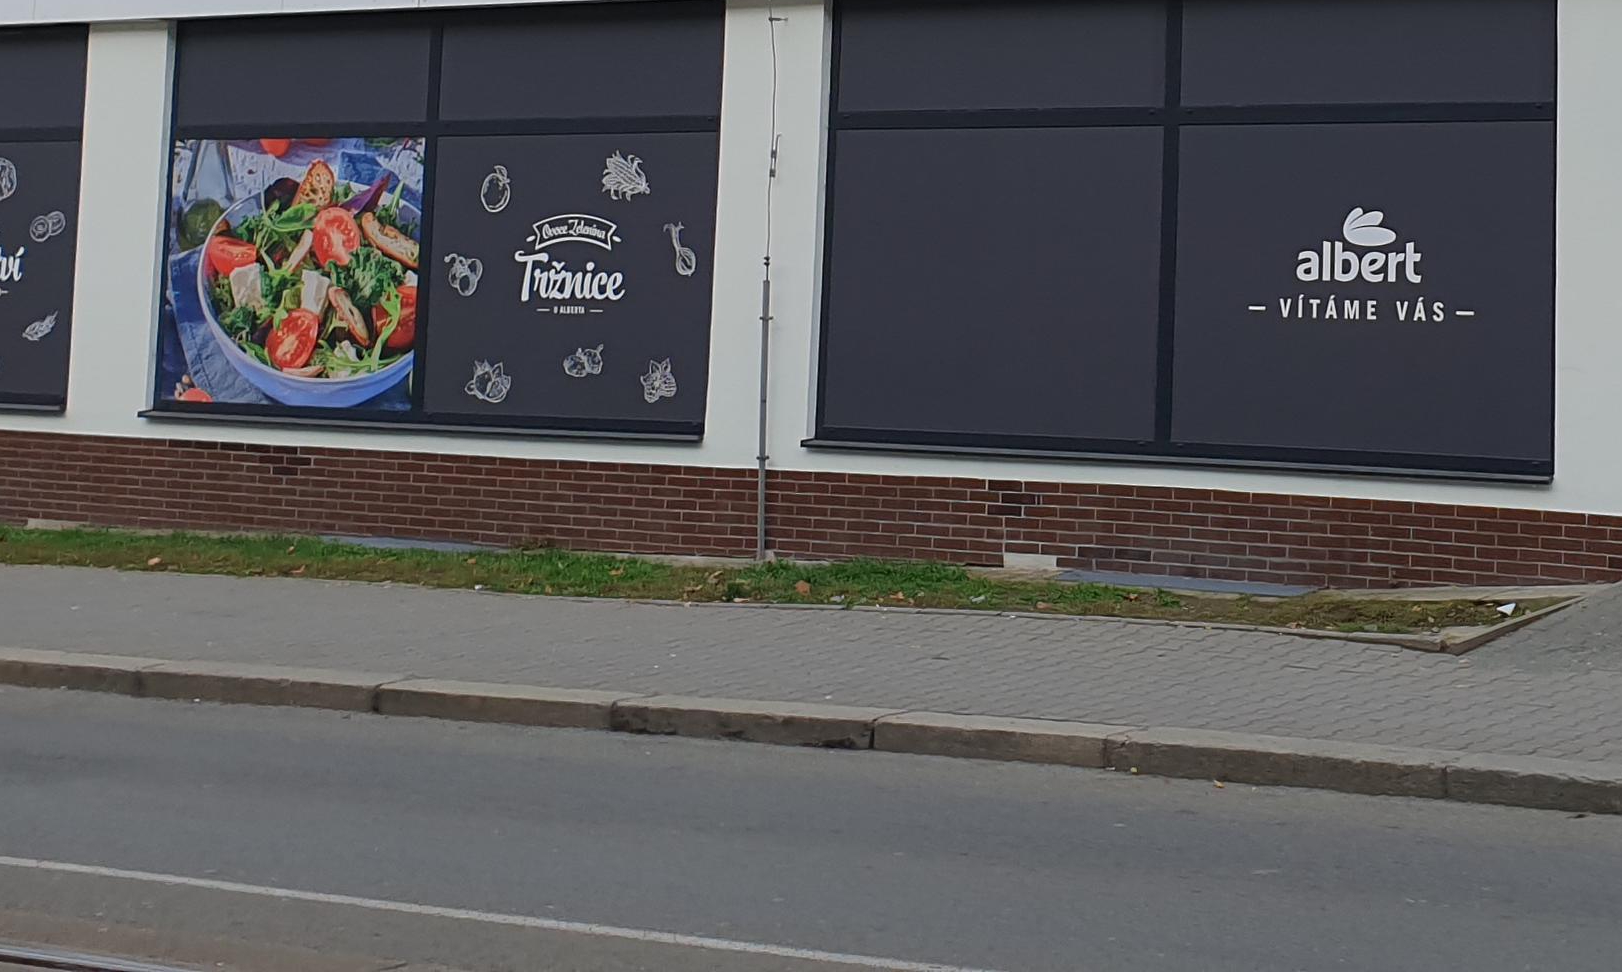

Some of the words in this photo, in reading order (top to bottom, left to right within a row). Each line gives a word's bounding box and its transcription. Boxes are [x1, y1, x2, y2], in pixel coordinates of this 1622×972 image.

[514, 250, 626, 302] Tržnice
[1296, 240, 1422, 284] albert
[1279, 294, 1377, 320] VÍTÁME
[1396, 297, 1445, 322] VÁS
